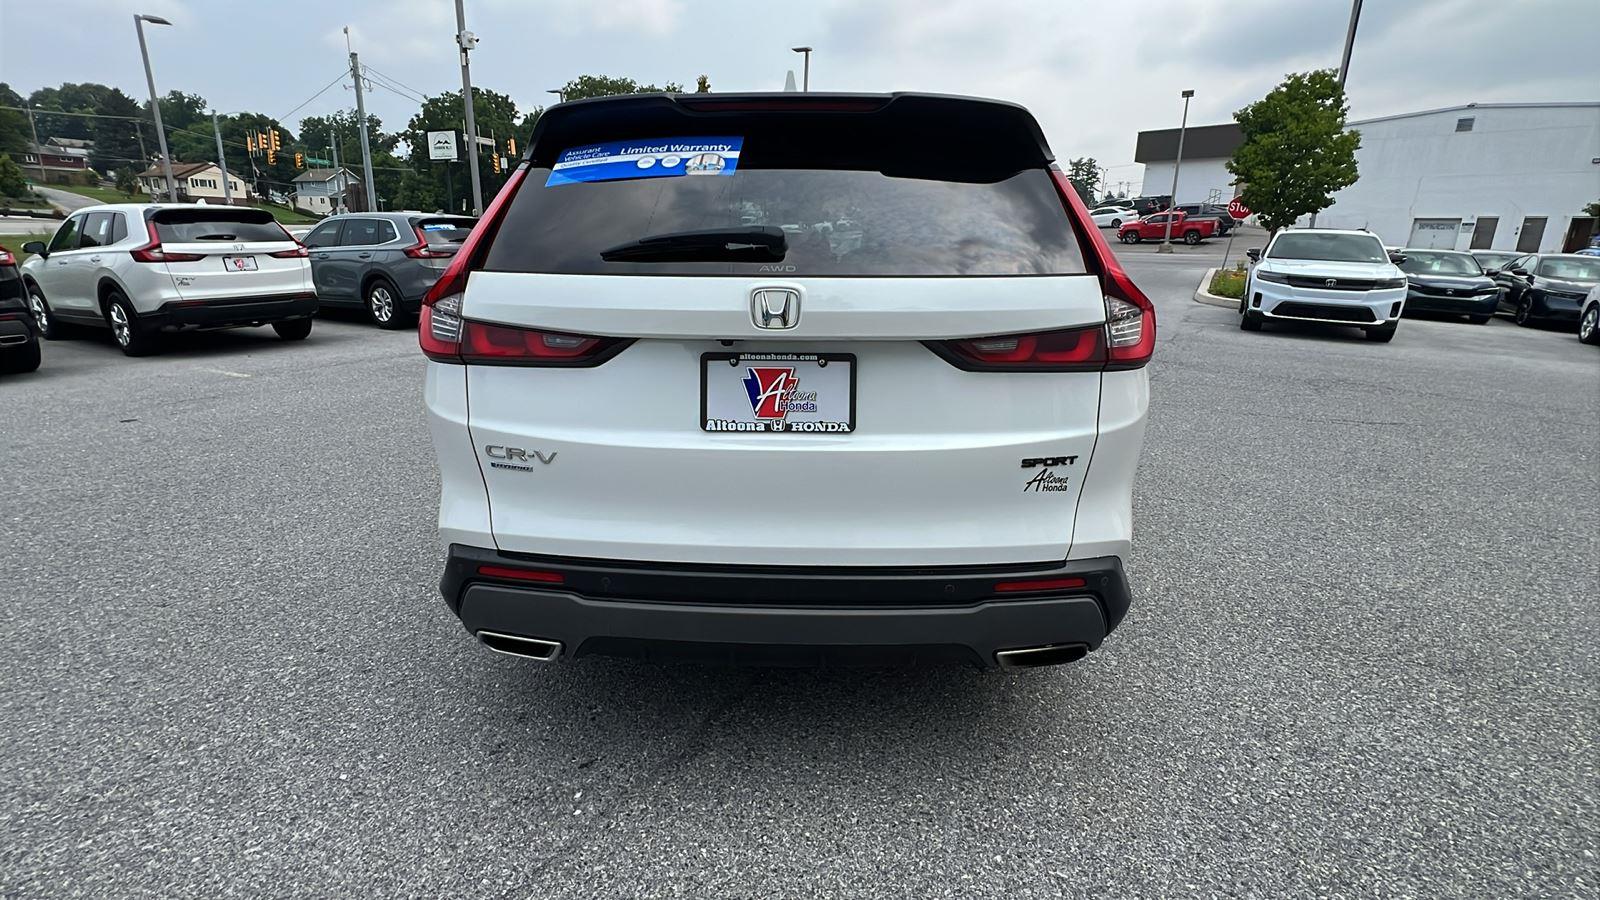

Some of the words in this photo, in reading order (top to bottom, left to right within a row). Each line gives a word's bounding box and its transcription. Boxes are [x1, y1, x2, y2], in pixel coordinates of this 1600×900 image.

[566, 147, 601, 156] Assurant
[620, 145, 668, 155] Limited
[670, 143, 731, 152] Warranty
[564, 153, 591, 162] Vehicle
[755, 372, 817, 412] Altoona
[780, 401, 816, 411] Honda
[705, 420, 765, 431] Altoona
[791, 422, 850, 432] HONDA
[485, 444, 558, 465] CR-V
[1021, 455, 1079, 468] SPORT
[1042, 484, 1068, 492] Honda
